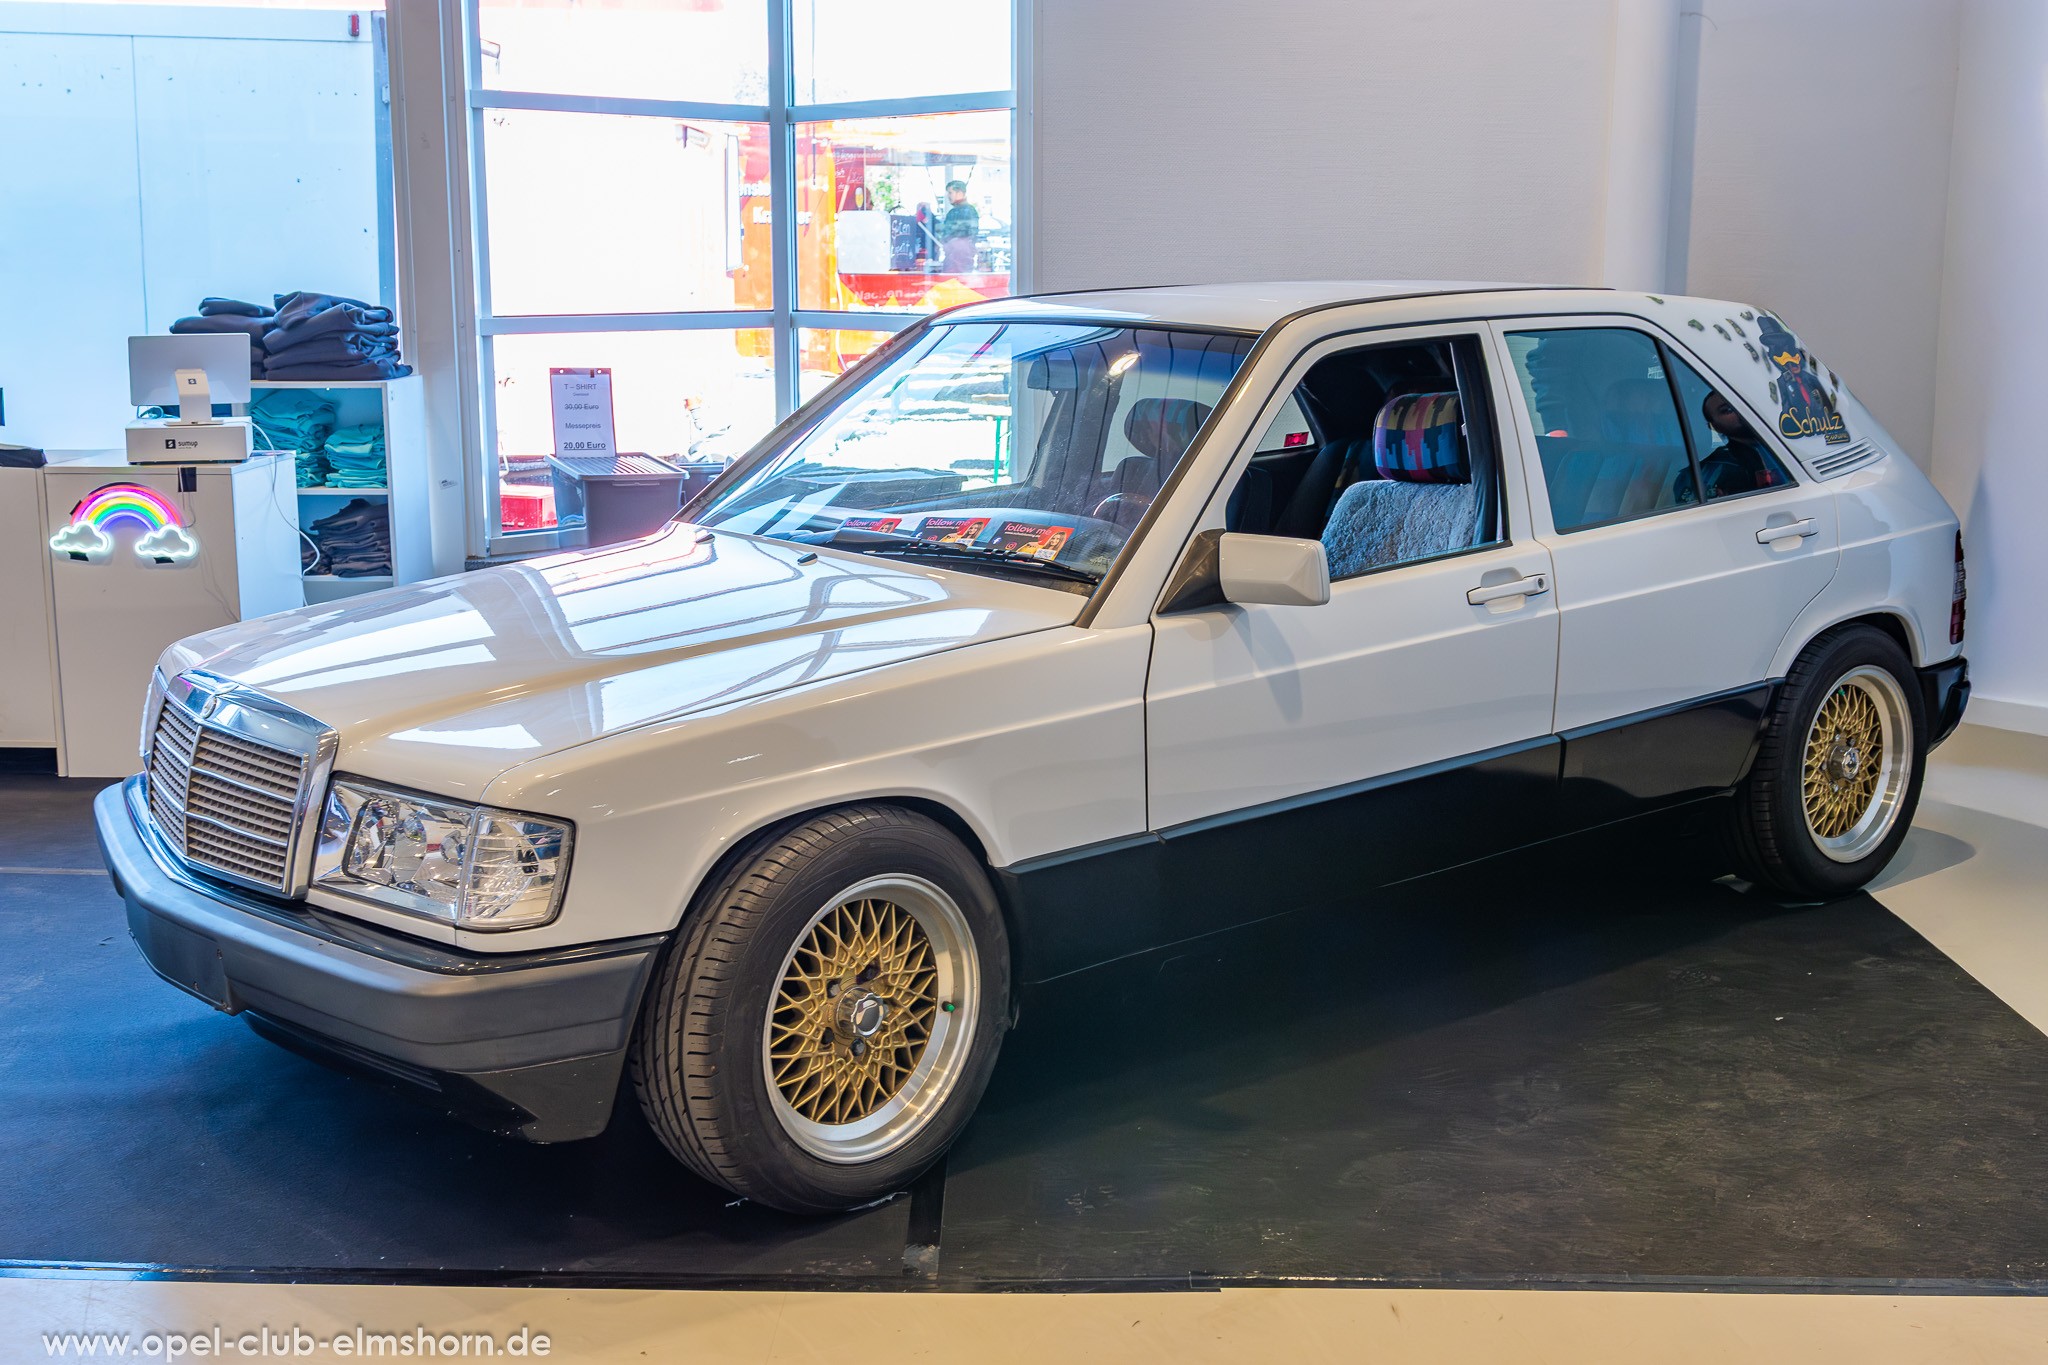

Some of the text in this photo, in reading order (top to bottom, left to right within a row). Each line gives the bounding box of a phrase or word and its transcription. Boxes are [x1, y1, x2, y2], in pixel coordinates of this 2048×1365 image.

[565, 422, 601, 430] Messepreis
[1780, 407, 1843, 436] Schulz
[564, 442, 585, 450] 20,00
[844, 519, 869, 527] follow
[926, 517, 971, 527] follow me
[1004, 522, 1036, 533] follow
[1035, 527, 1052, 535] me
